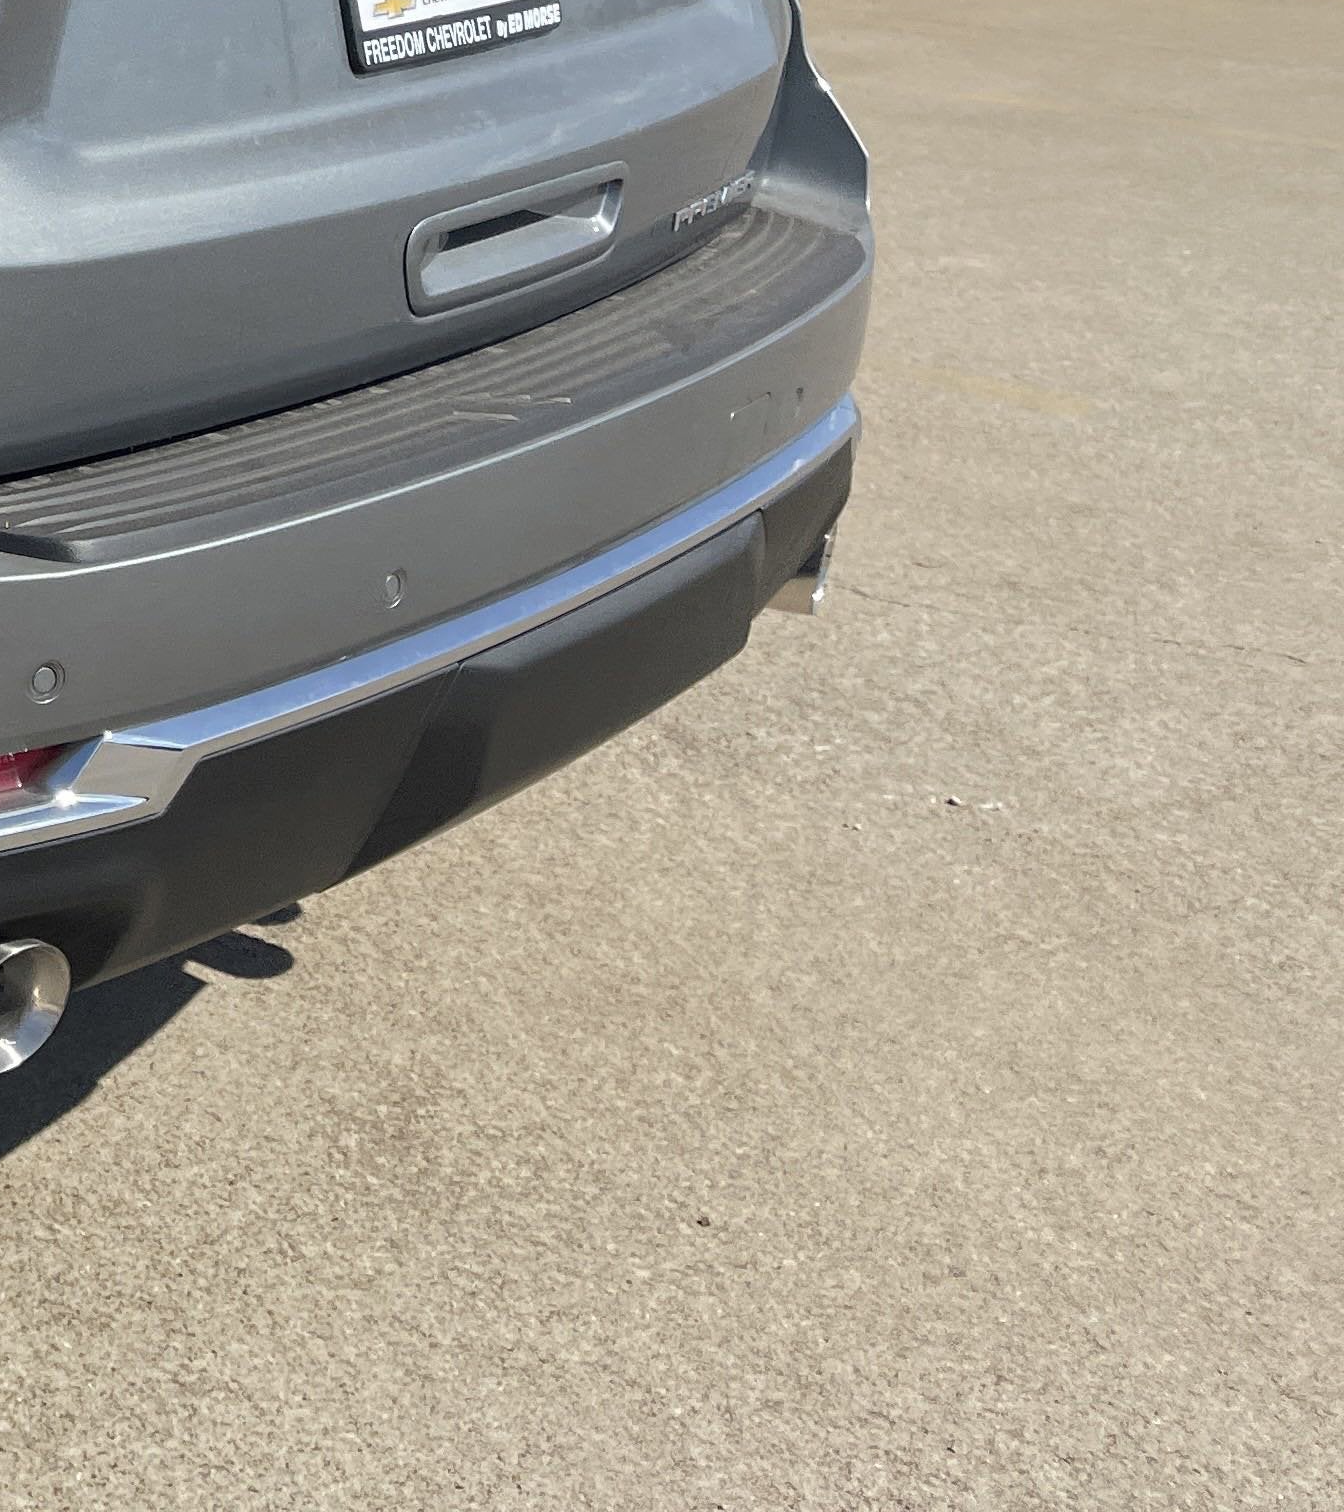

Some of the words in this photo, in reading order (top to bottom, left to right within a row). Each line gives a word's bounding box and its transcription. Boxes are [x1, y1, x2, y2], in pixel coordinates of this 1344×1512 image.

[363, 29, 426, 66] FREEDOM
[426, 15, 492, 53] CHEVROLET
[507, 12, 524, 34] ED
[523, 3, 561, 30] MORSE
